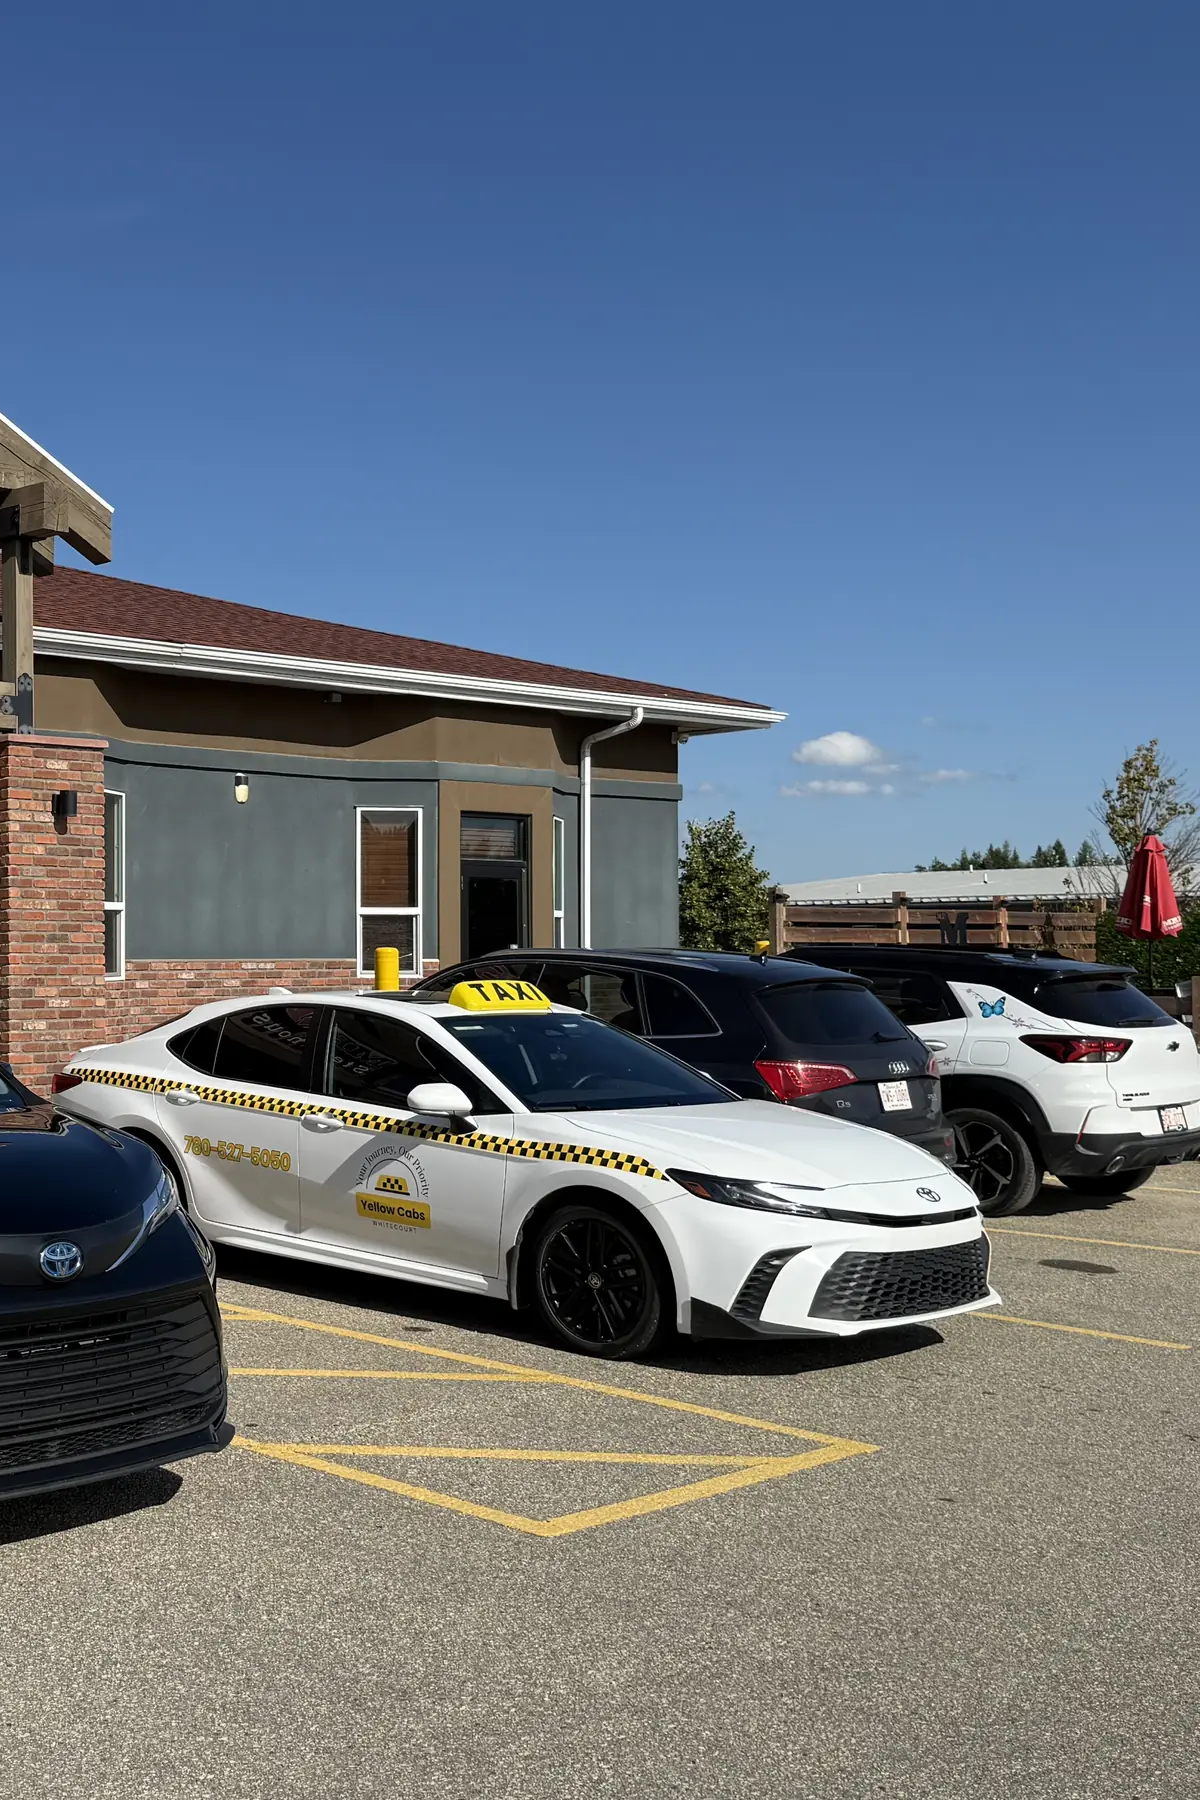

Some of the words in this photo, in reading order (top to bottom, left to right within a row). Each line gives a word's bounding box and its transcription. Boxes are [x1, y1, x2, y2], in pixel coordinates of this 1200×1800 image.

[467, 982, 544, 1002] TAXI
[183, 1134, 291, 1172] 780-527-5050
[356, 1162, 369, 1186] Your
[364, 1145, 397, 1167] Journey,
[399, 1145, 415, 1162] Our
[412, 1158, 430, 1198] Priority
[360, 1199, 396, 1216] Yellow
[397, 1206, 426, 1221] Cabs
[372, 1220, 417, 1234] WHITECOURT
